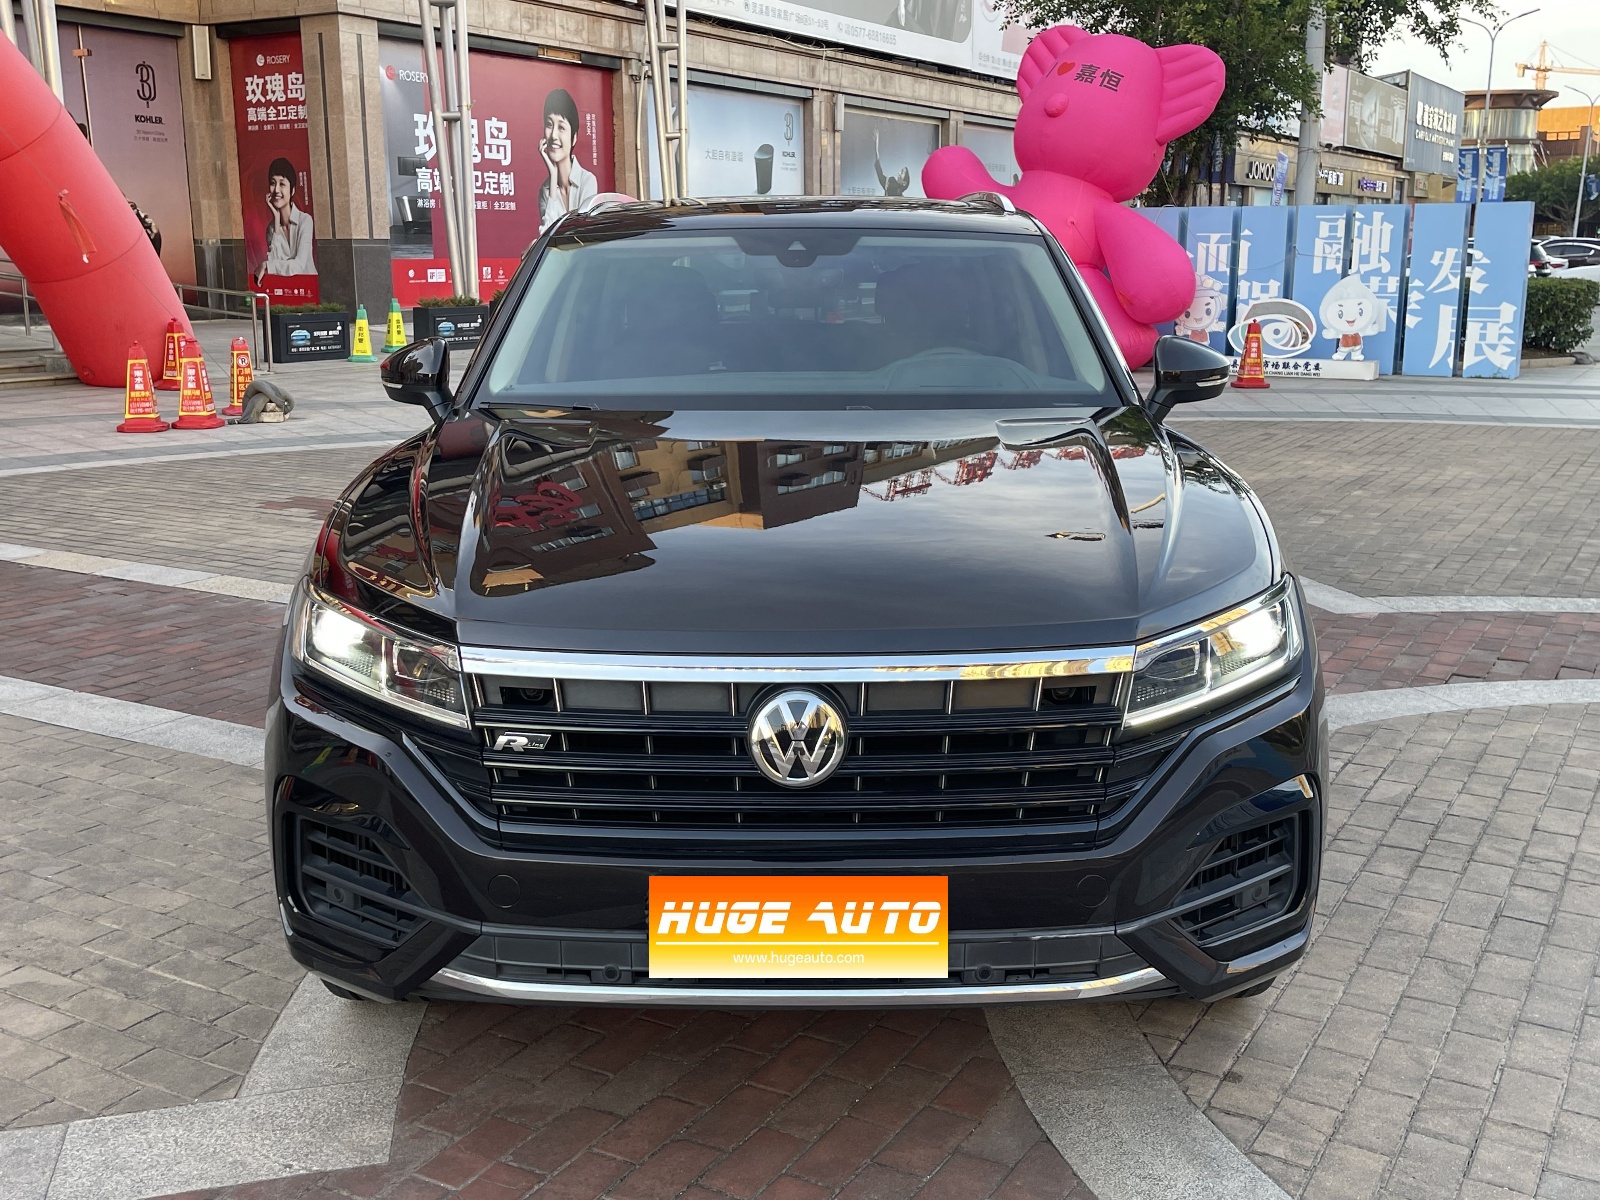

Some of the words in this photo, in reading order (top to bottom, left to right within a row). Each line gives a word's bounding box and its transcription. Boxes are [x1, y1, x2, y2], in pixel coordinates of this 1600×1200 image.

[266, 55, 290, 64] ROSERY
[1074, 64, 1124, 92] 嘉恒
[245, 72, 306, 104] 玫瑰岛
[134, 115, 164, 125] KOHLER
[247, 105, 308, 122] 高端全卫定制
[1248, 161, 1275, 181] JOMOO
[493, 735, 529, 752] R
